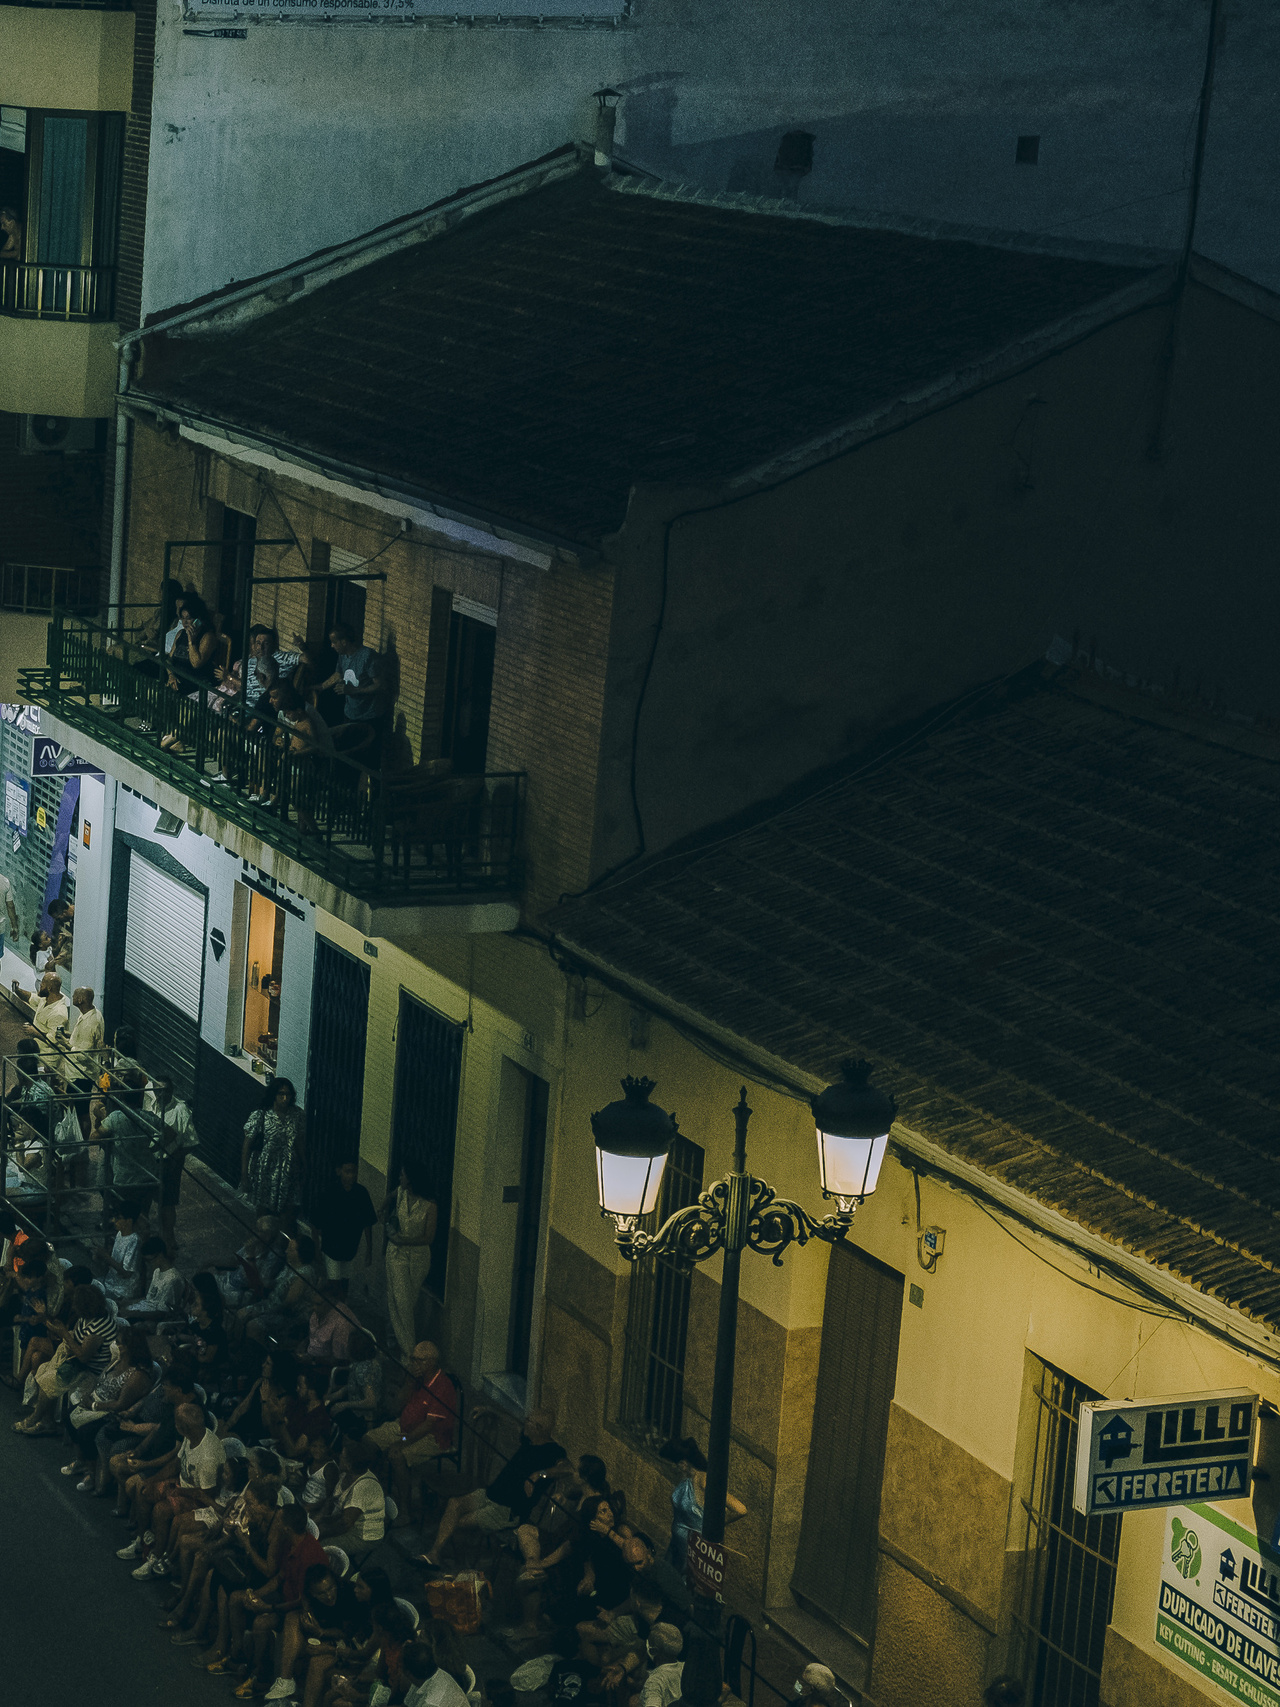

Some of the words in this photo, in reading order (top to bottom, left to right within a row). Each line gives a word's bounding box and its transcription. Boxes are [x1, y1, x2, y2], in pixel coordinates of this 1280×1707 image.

[320, 0, 382, 9] responsable.
[1143, 1402, 1253, 1464] LILLO
[1121, 1465, 1242, 1500] FERRETERIA
[695, 1536, 724, 1567] ZONA
[698, 1557, 723, 1582] TIRO
[1239, 1556, 1280, 1617] LILL
[1162, 1586, 1225, 1646] DUPLICADO
[1226, 1630, 1243, 1659] DE
[1226, 1592, 1280, 1642] FERRETERI
[1159, 1622, 1173, 1643] KEY
[1173, 1634, 1205, 1666] CUTTING
[1211, 1659, 1239, 1690] ERSATZ
